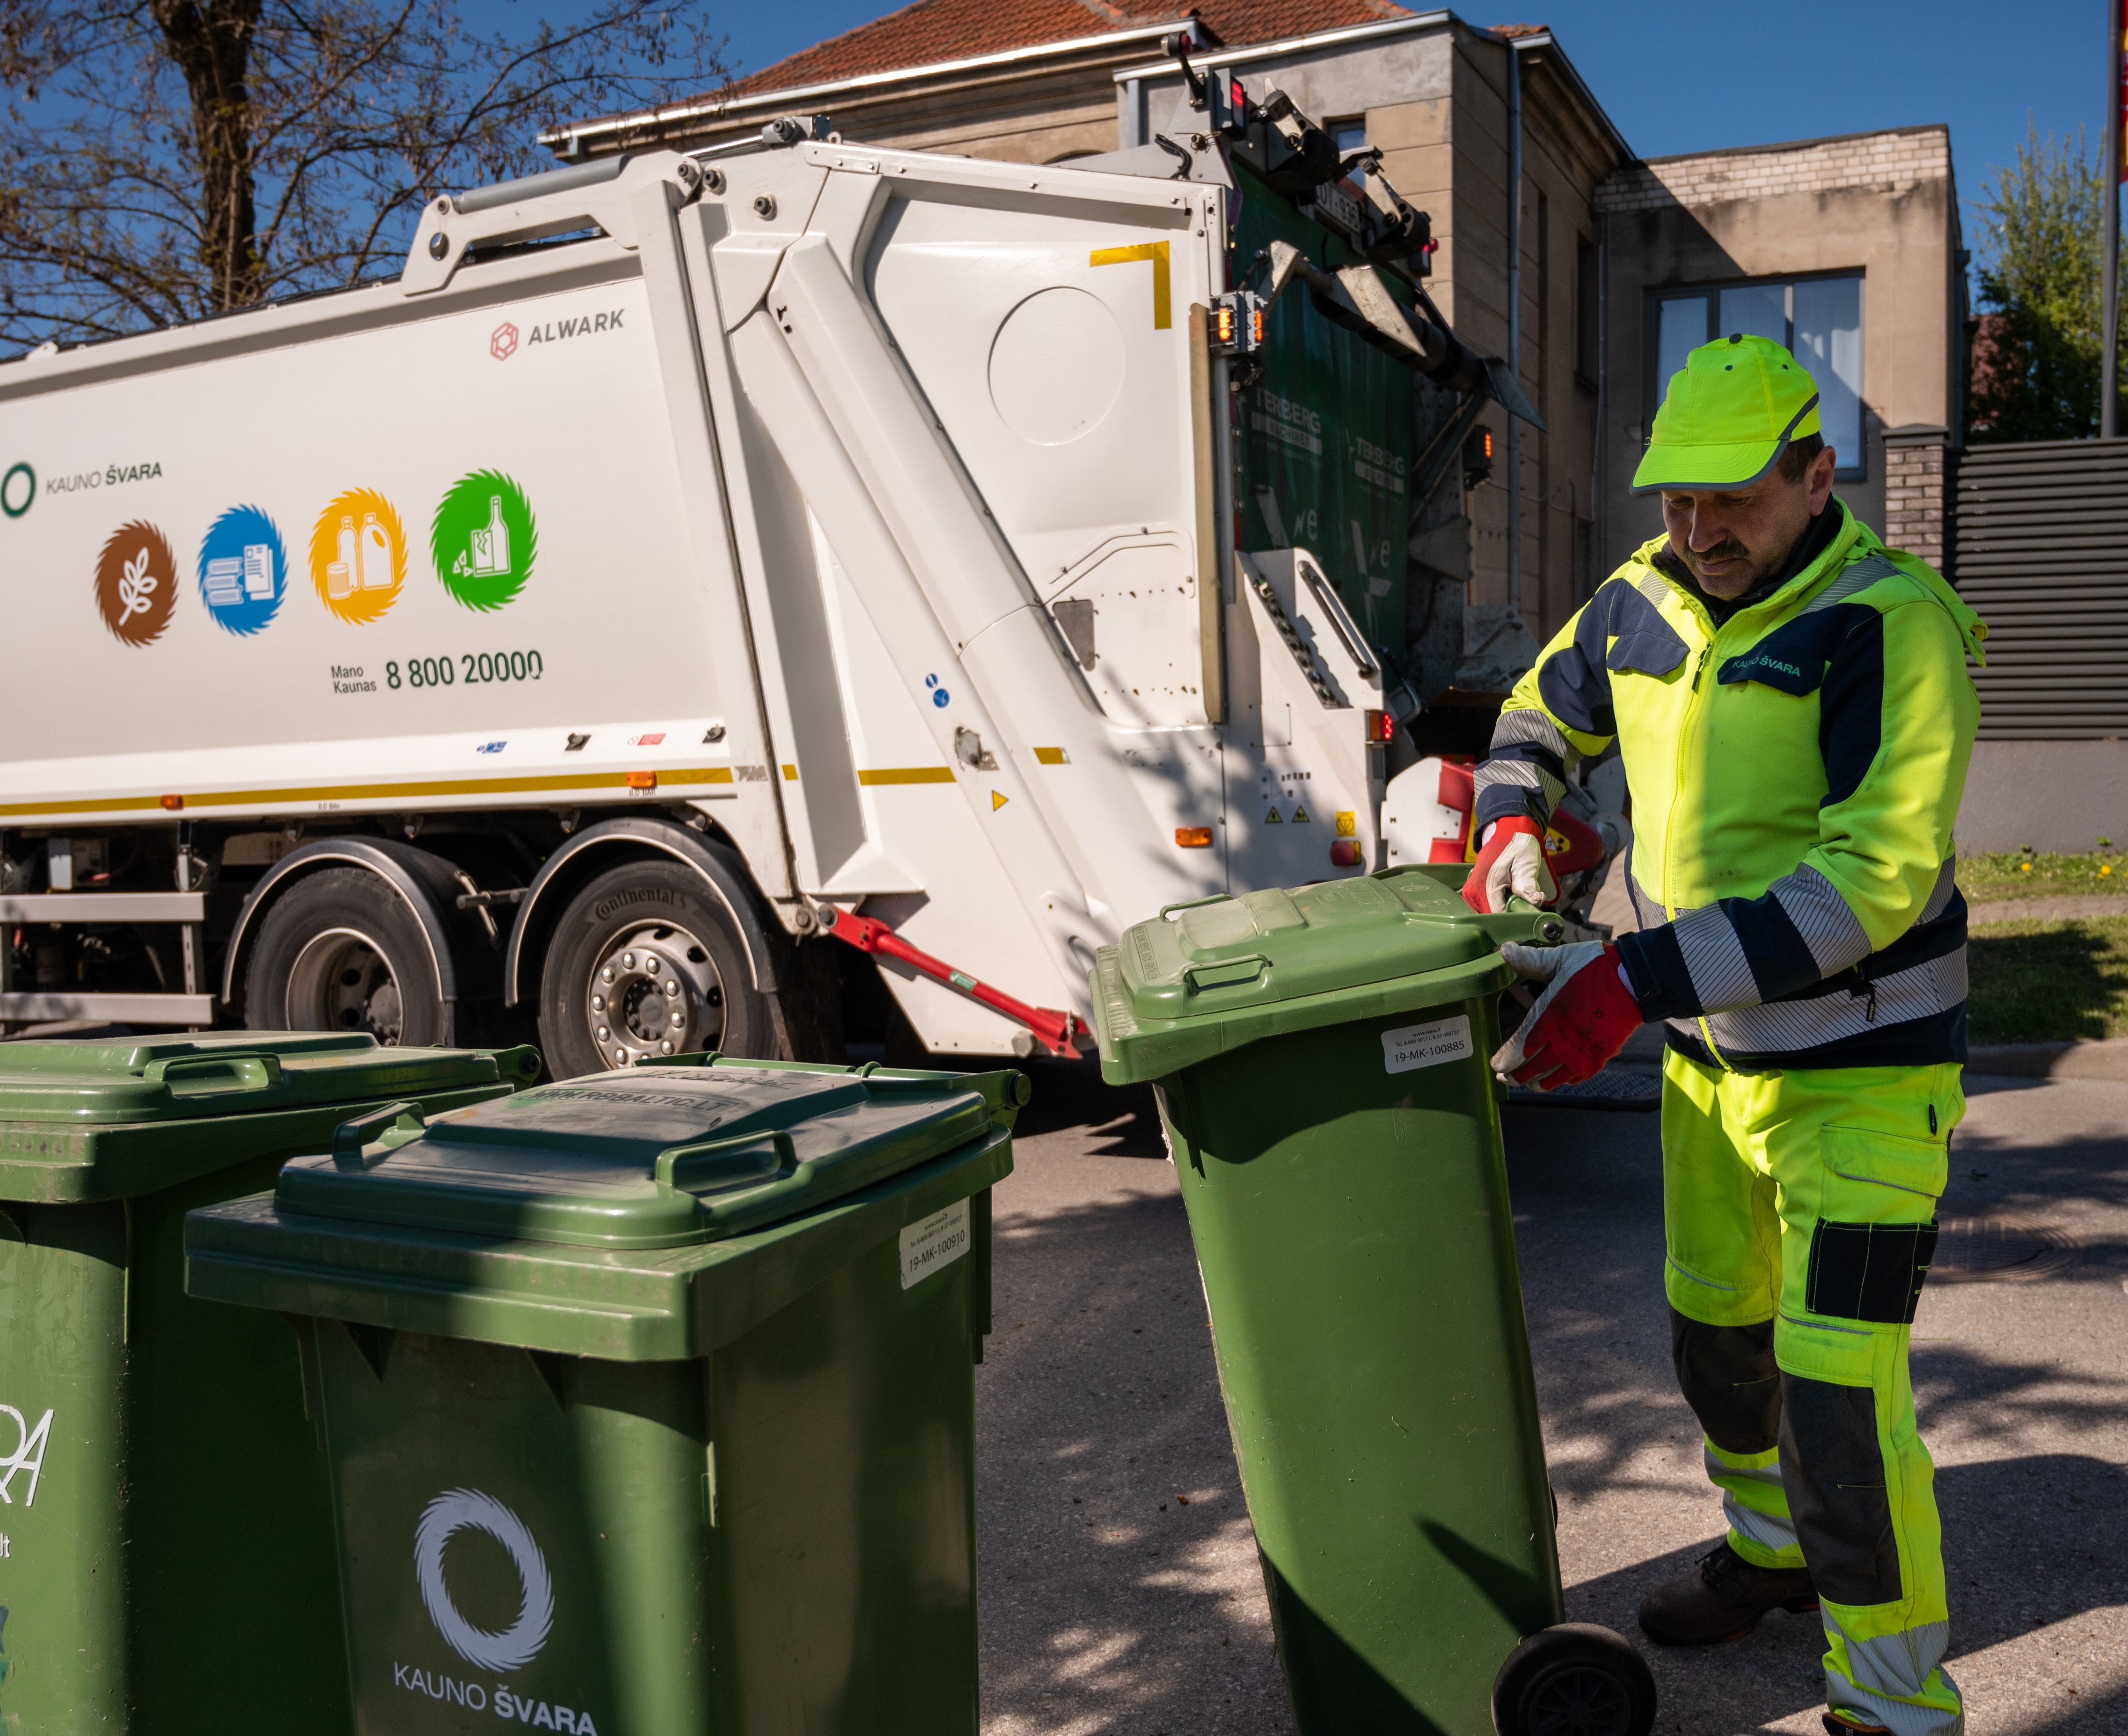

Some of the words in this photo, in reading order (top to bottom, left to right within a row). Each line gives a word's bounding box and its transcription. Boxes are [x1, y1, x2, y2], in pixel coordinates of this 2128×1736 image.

[528, 308, 625, 346] ALWARK
[46, 471, 101, 495] KAUNO
[105, 461, 162, 486] ŠVARA
[331, 664, 364, 679] Mano
[386, 661, 401, 690] 8
[410, 656, 455, 688] 800
[461, 649, 543, 684] 20000
[1759, 656, 1800, 677] ŠVARA
[334, 678, 377, 693] Kaunas
[595, 889, 675, 920] Continental
[1412, 1027, 1441, 1037] www.svara.lt
[1417, 1036, 1433, 1044] 00111,
[1394, 1040, 1465, 1063] 19-MK-100885
[909, 1229, 965, 1272] 19-MK-100910
[393, 1661, 486, 1711] KAUNO
[494, 1683, 597, 1736] ŠVARA
